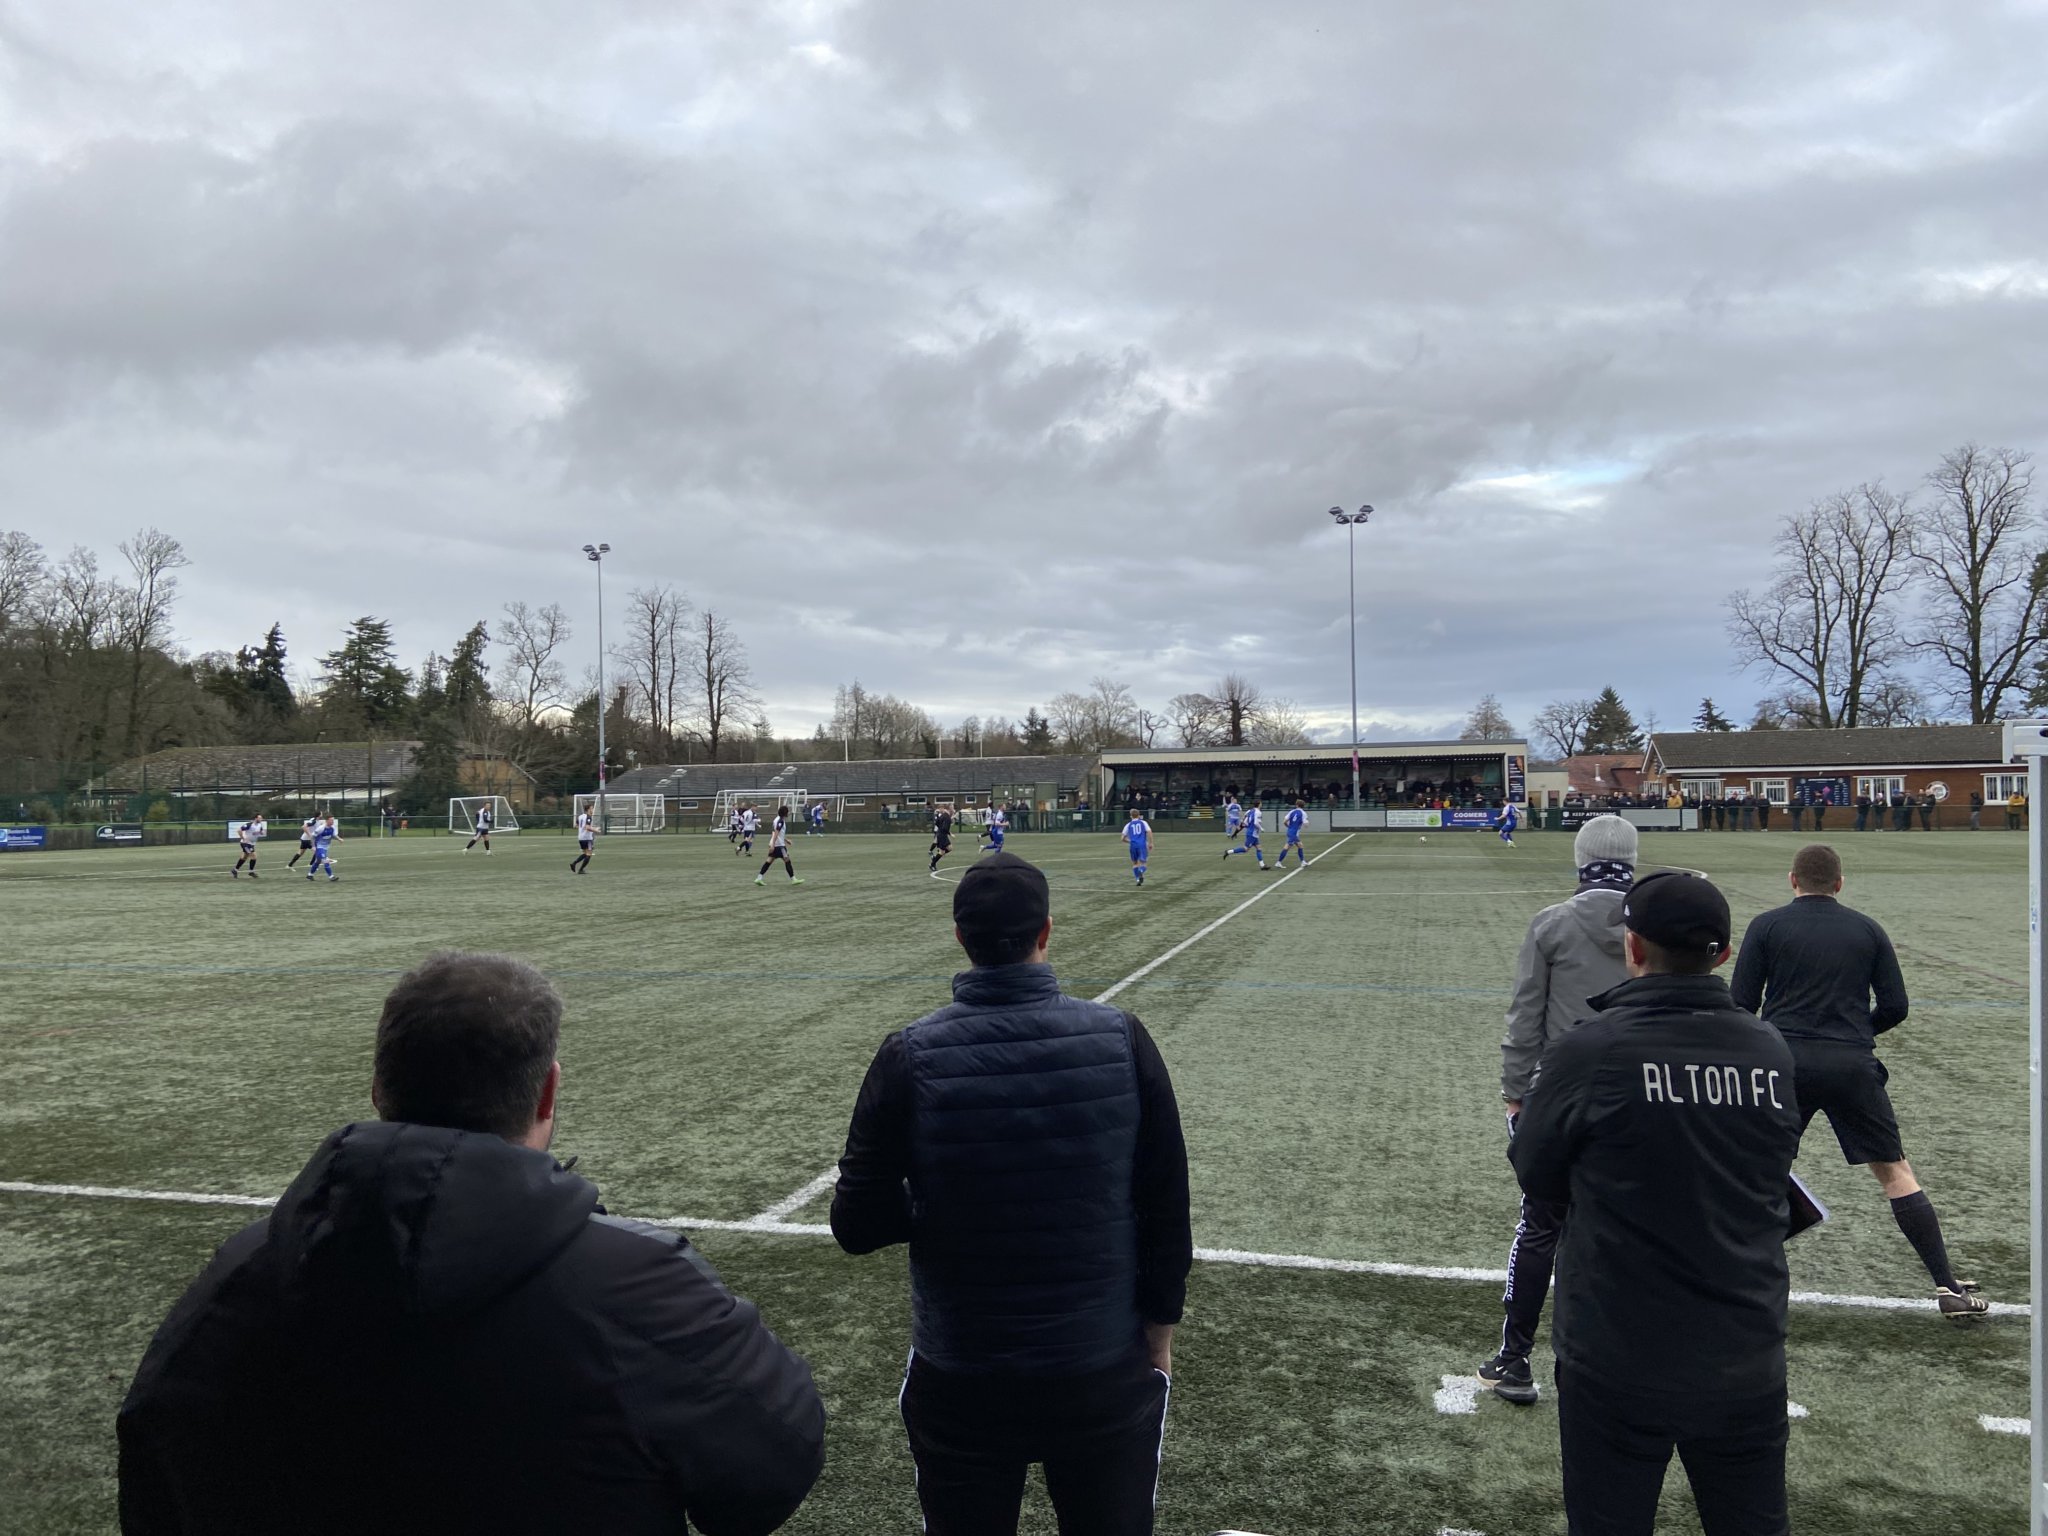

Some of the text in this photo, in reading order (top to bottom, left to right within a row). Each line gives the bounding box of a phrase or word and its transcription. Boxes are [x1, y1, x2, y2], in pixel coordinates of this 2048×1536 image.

[1131, 823, 1142, 835] 10
[1642, 1062, 1783, 1109] ALTON FC
